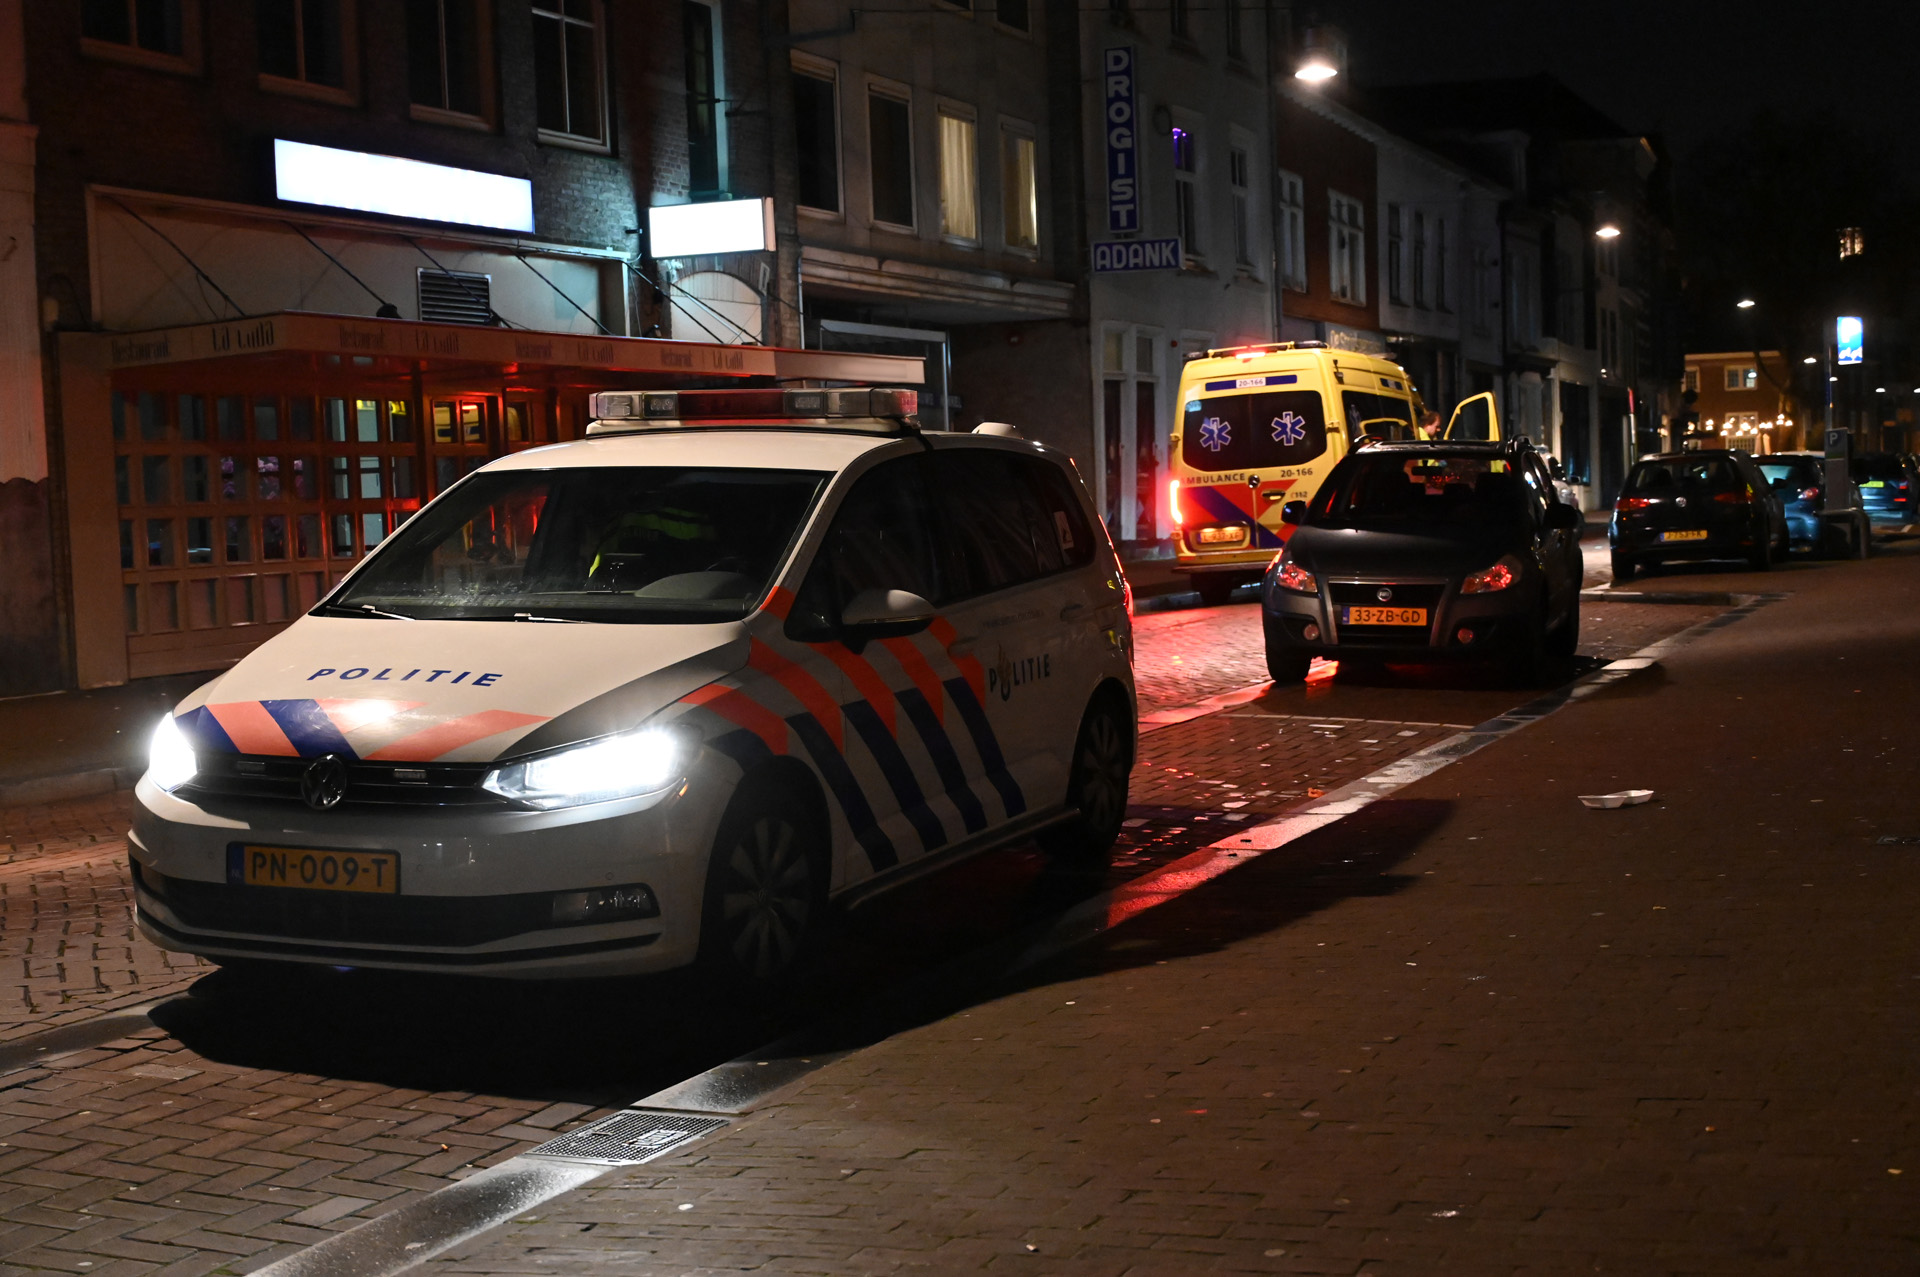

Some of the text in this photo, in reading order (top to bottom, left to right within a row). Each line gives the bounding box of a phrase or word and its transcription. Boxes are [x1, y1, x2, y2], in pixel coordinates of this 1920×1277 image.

[1106, 49, 1135, 228] DROGIST
[1095, 241, 1178, 270] ADANK
[1238, 378, 1264, 387] 20-166
[1829, 432, 1839, 445] P
[1280, 468, 1313, 478] 20-166
[1353, 609, 1421, 623] 33-ZB-GD
[306, 667, 504, 687] POLITIE
[251, 851, 389, 887] PN-009-T
